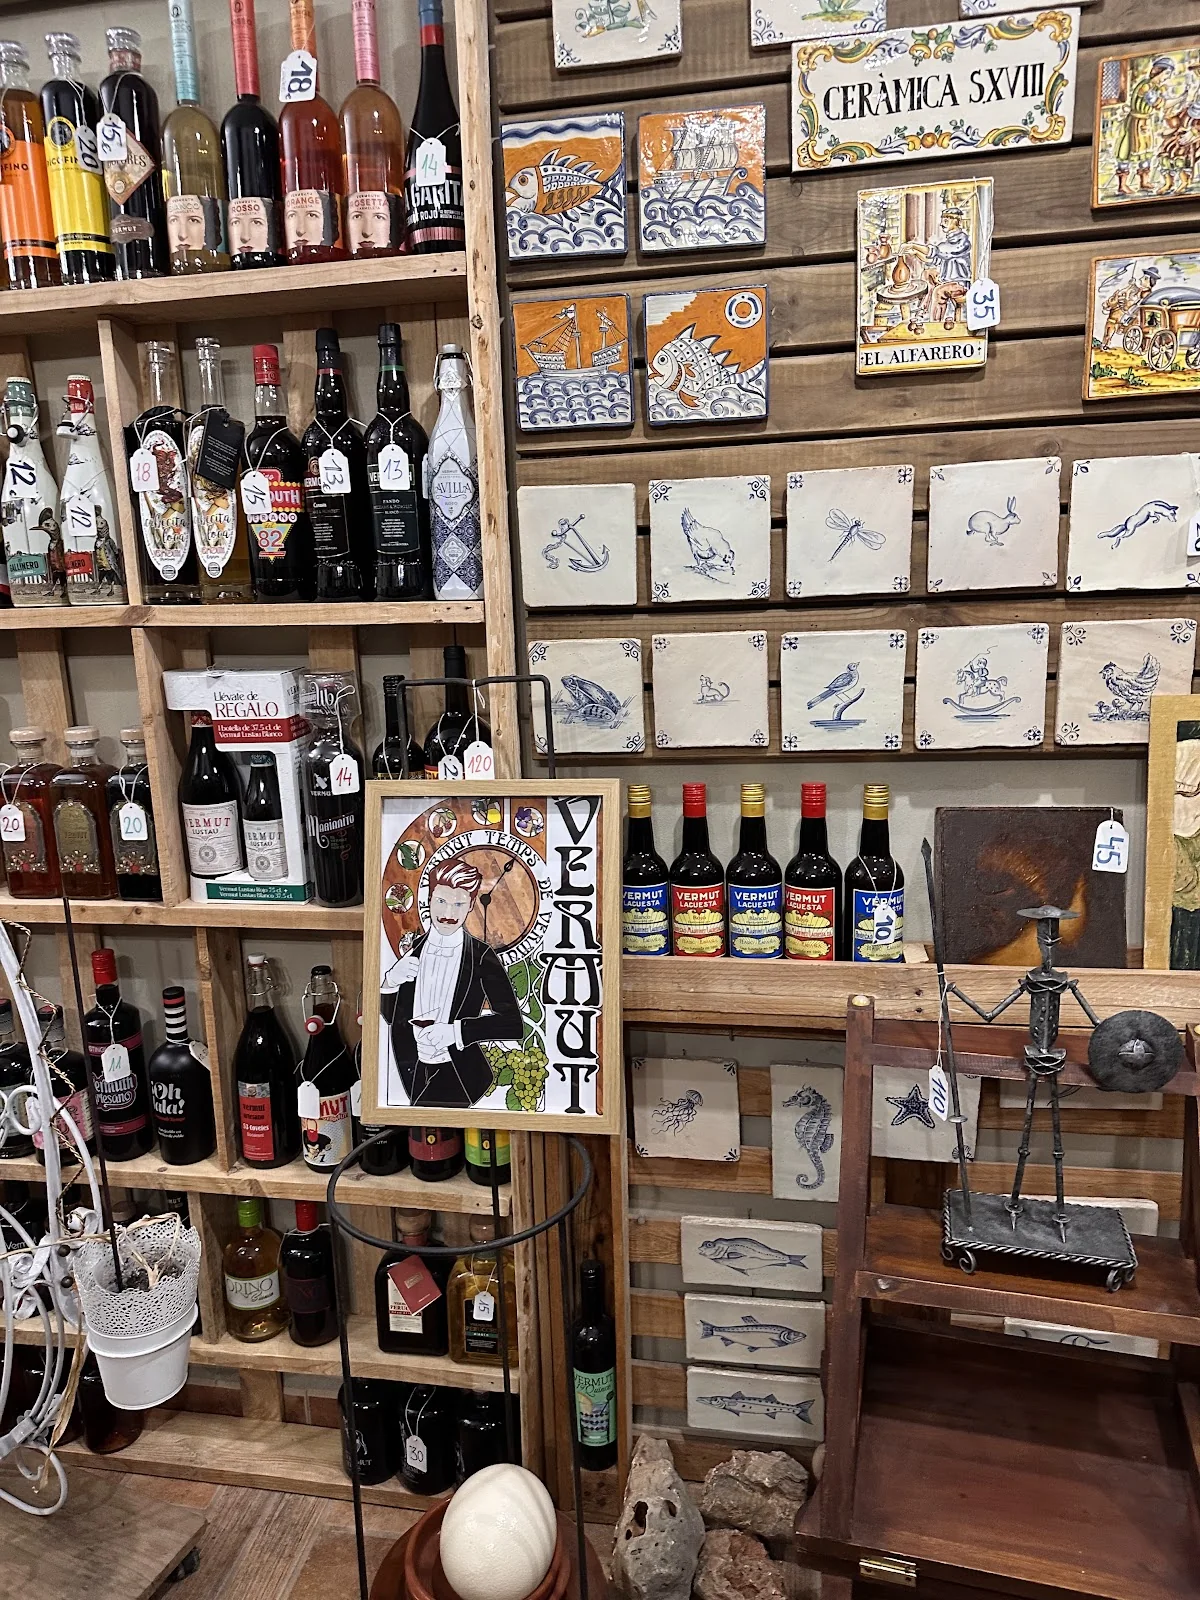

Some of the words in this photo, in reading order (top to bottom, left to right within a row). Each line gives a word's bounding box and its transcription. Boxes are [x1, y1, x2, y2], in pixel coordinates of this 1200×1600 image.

[823, 73, 960, 121] CERÀMICA
[77, 135, 99, 169] 20
[421, 153, 438, 179] 14
[286, 196, 321, 208] ORANGE
[349, 198, 389, 207] ROSETTA
[410, 180, 463, 208] GARIT
[231, 204, 260, 213] ROSSO
[972, 288, 996, 321] 35
[864, 351, 884, 366] EL
[889, 343, 975, 364] ALFARERO
[135, 462, 151, 482] 18
[383, 458, 403, 481] 13
[243, 484, 267, 509] 15
[69, 505, 92, 529] 12
[258, 529, 284, 549] 82
[213, 691, 245, 701] Llévate
[246, 690, 260, 701] de
[214, 701, 279, 718] REGALO
[242, 724, 250, 732] de
[468, 754, 492, 774] 120
[335, 766, 353, 787] 14
[2, 815, 20, 833] 20
[123, 816, 143, 834] 20
[485, 830, 541, 868] TEMPS
[1096, 836, 1125, 866] 45
[623, 899, 661, 908] LACUESTA
[676, 890, 720, 901] VERMUT
[679, 900, 718, 908] LACUESTA
[734, 889, 779, 901] VERMUT
[737, 900, 776, 908] LACUESTA
[785, 891, 827, 904] VERMUT
[786, 899, 823, 911] LACUESTA
[875, 914, 894, 941] 10
[541, 797, 603, 1114] VERMUT
[109, 1055, 122, 1072] 11
[931, 1077, 947, 1114] 110
[478, 1299, 490, 1315] 15
[409, 1444, 424, 1463] 30
